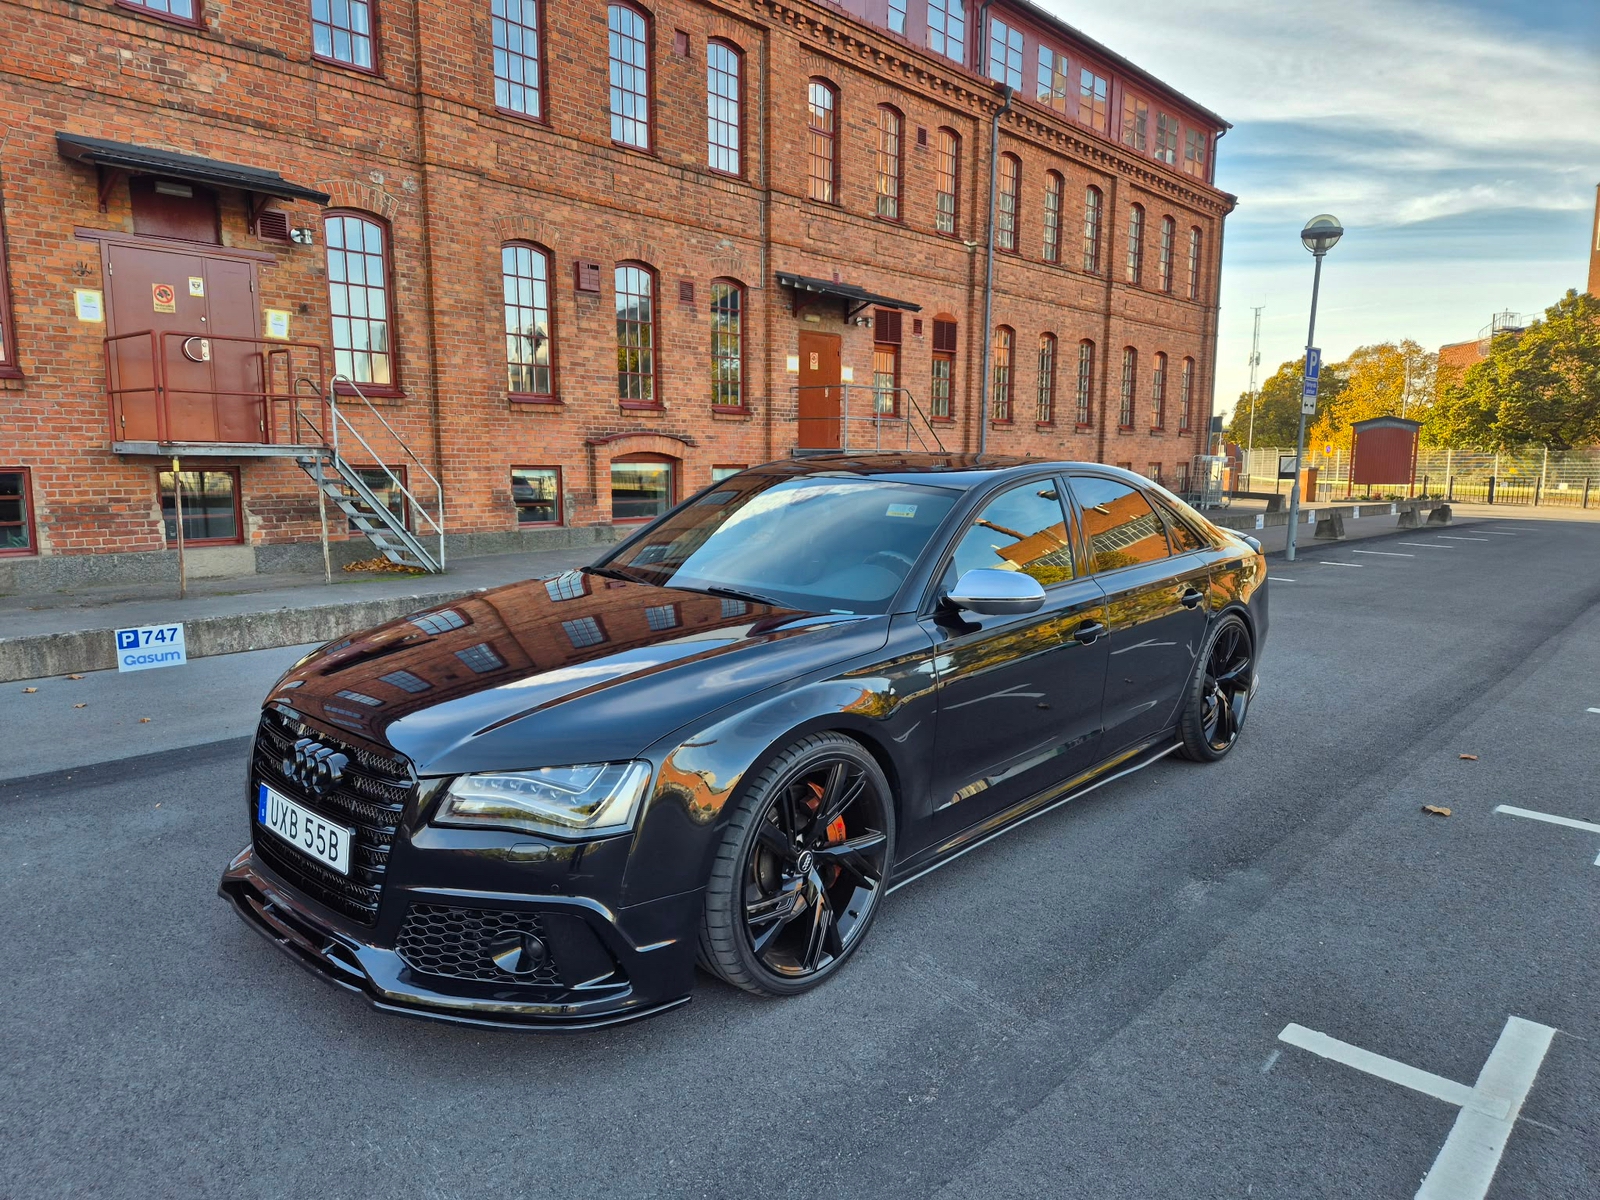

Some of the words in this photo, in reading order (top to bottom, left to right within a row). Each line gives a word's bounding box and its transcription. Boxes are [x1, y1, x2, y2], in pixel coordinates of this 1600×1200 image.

[1309, 351, 1318, 376] P
[121, 632, 135, 647] P
[141, 627, 178, 645] 747
[123, 650, 181, 666] Gasum
[270, 796, 298, 840] UXB
[304, 817, 339, 863] 55B
